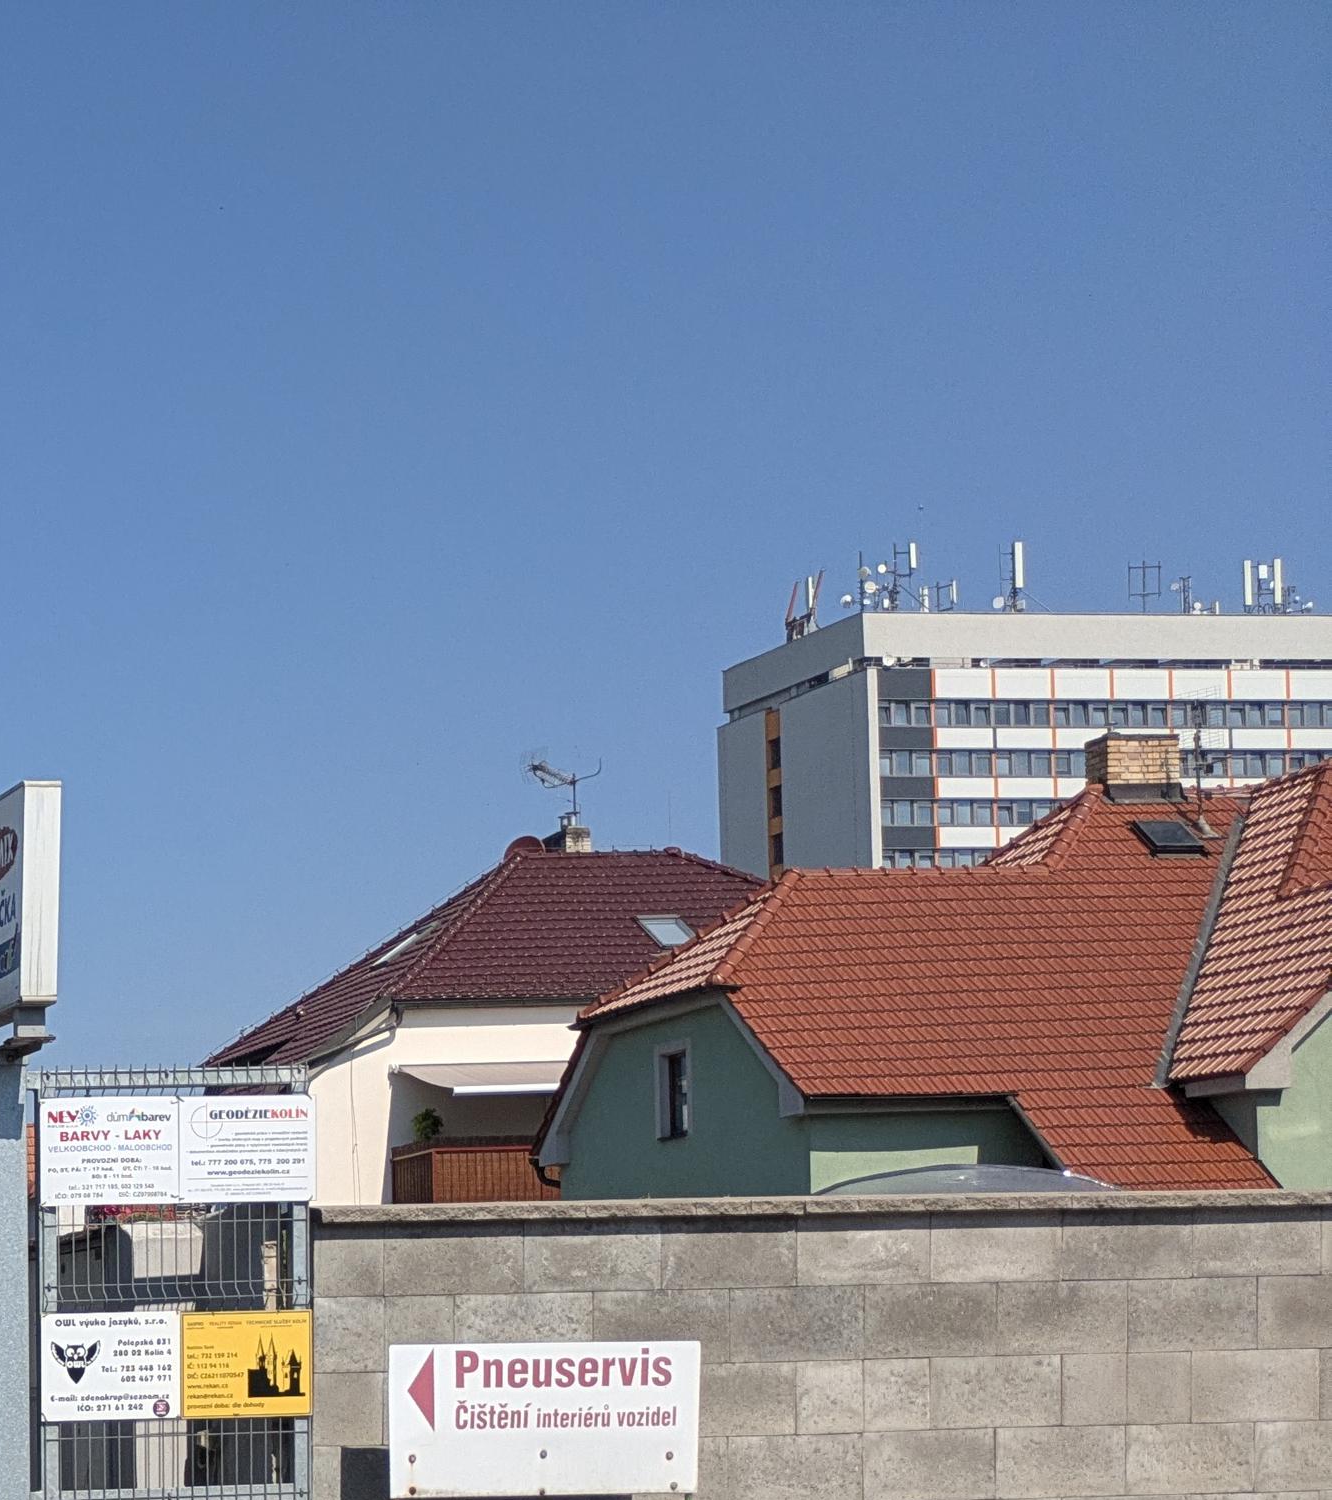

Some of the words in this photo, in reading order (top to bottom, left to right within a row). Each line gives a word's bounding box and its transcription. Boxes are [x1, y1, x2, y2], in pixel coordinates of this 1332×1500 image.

[106, 1112, 129, 1122] dům
[141, 1112, 171, 1122] barev
[59, 1130, 111, 1142] BARVY
[124, 1129, 161, 1140] LAKY
[48, 1145, 112, 1153] VELKOOBCHOD
[118, 1143, 173, 1151] MALOOBCHOD
[55, 1319, 77, 1327] OWL
[79, 1319, 106, 1328] výuka
[108, 1317, 142, 1328] jazyků,
[455, 1347, 673, 1389] Pneuservis
[157, 1374, 172, 1382] 971
[455, 1400, 532, 1430] Čištění
[536, 1404, 611, 1429] interiérů
[617, 1406, 677, 1428] vozidel
